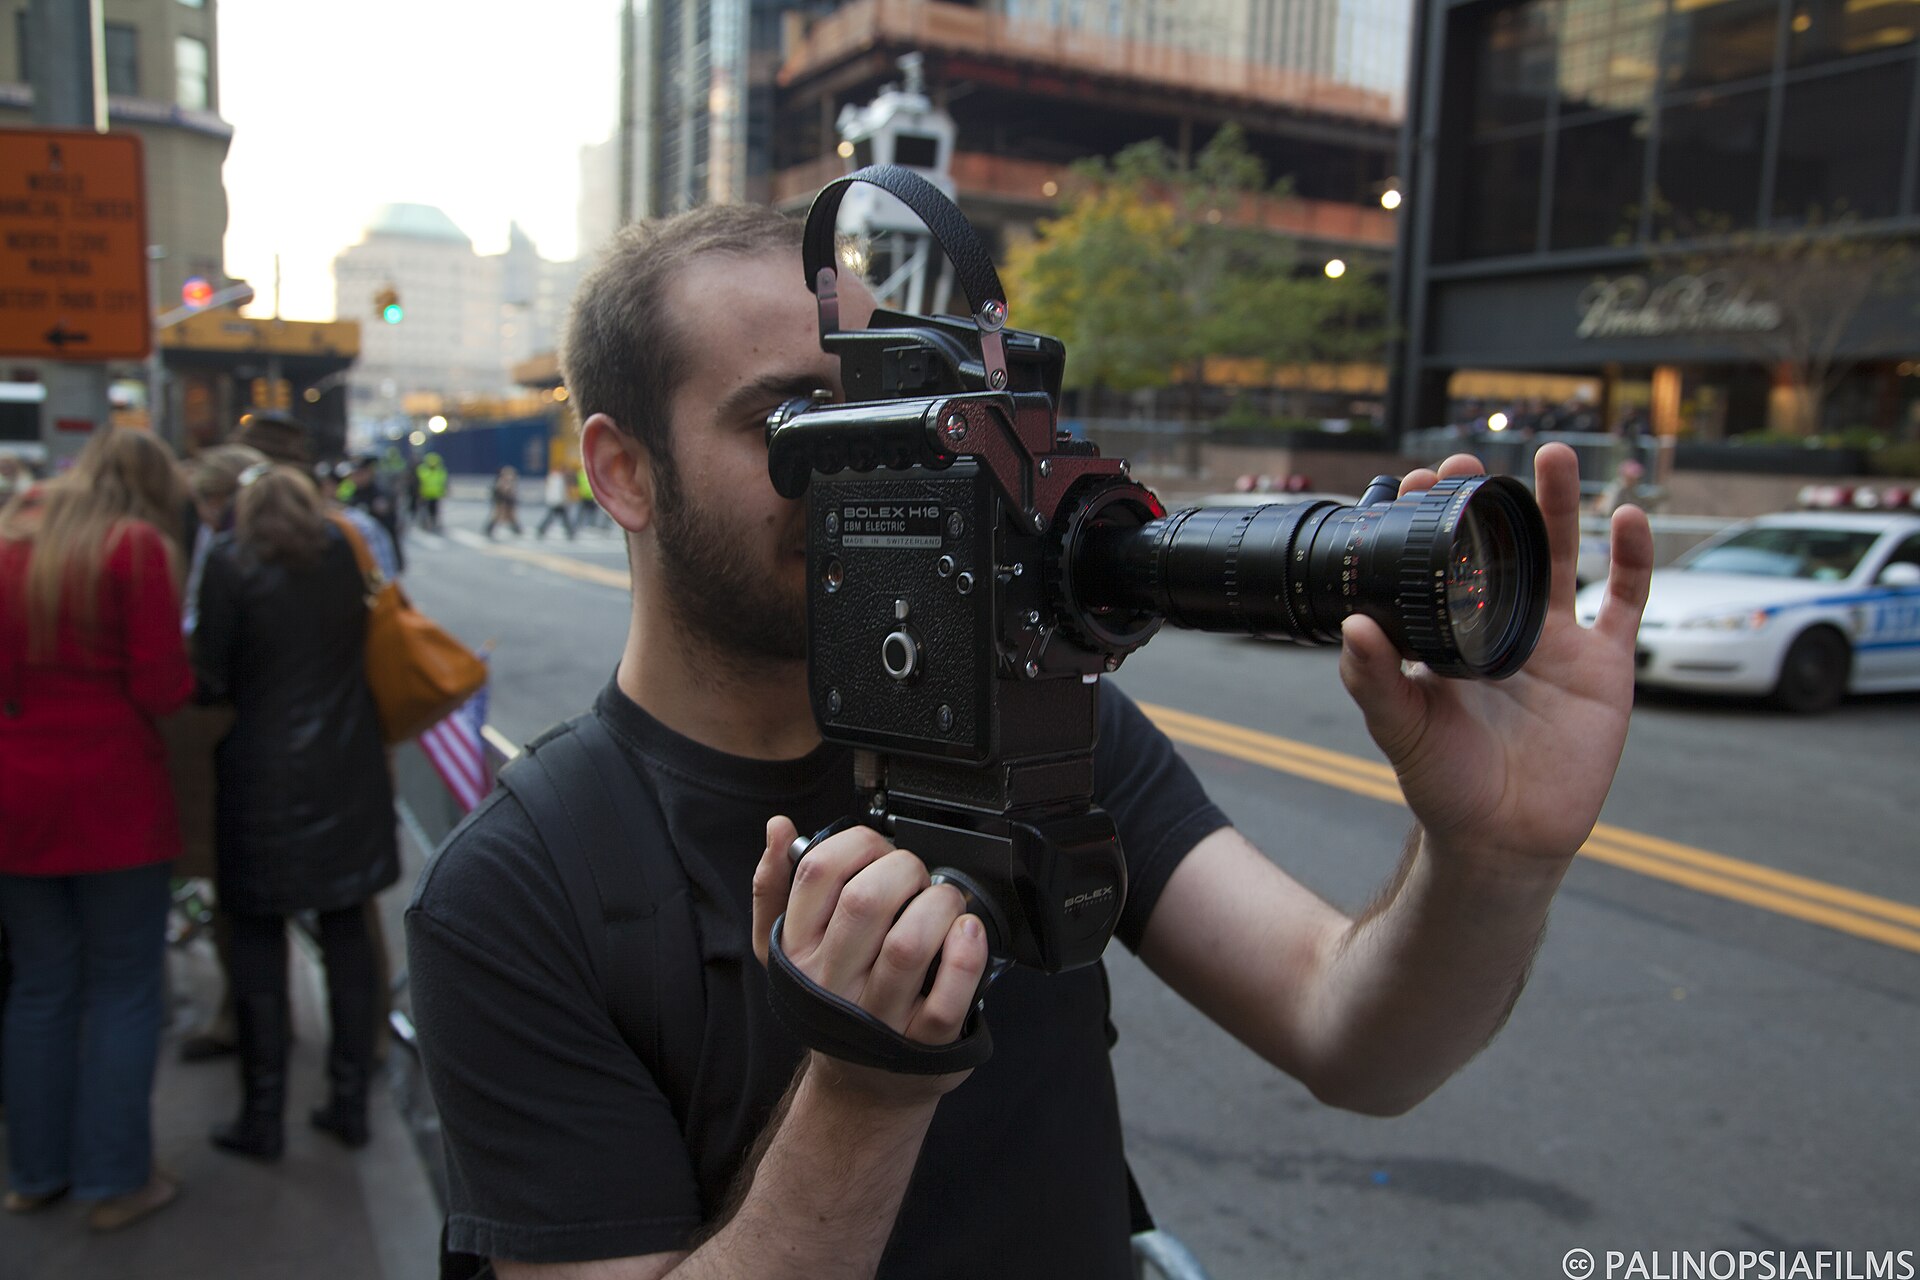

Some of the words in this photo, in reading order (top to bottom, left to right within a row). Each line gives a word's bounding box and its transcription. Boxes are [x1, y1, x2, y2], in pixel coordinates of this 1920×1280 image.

[844, 507, 904, 518] BOLEX
[909, 507, 940, 518] H16
[844, 521, 861, 532] EBM
[865, 521, 906, 532] ELECTRIC
[844, 538, 864, 546] MADE
[886, 538, 940, 546] SWITZERLAND
[1064, 885, 1113, 908] BOLEX
